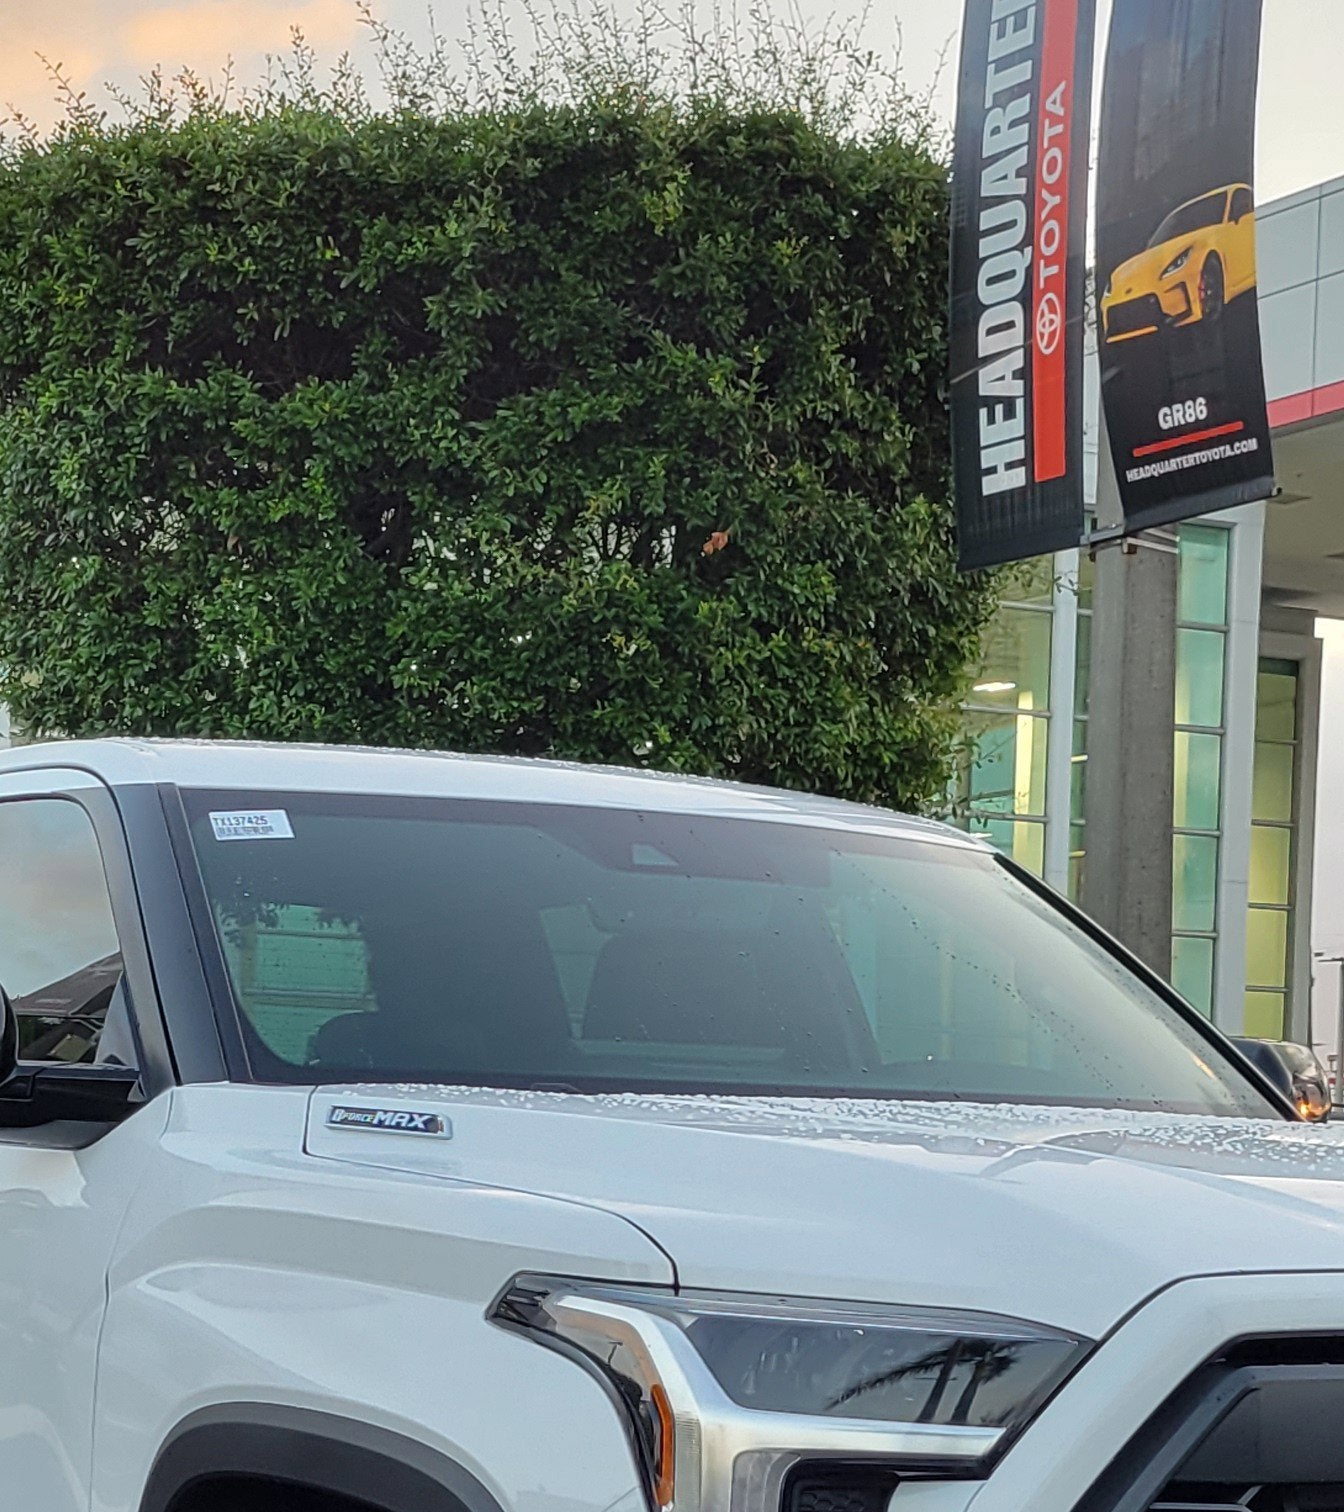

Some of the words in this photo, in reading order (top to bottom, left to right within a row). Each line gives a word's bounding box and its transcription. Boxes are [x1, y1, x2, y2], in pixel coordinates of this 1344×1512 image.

[1040, 80, 1067, 289] TOYOTA
[1158, 397, 1208, 430] GR86
[1125, 437, 1258, 483] HEADQUARTERTOYOTA.COM
[373, 1111, 432, 1130] MAX
